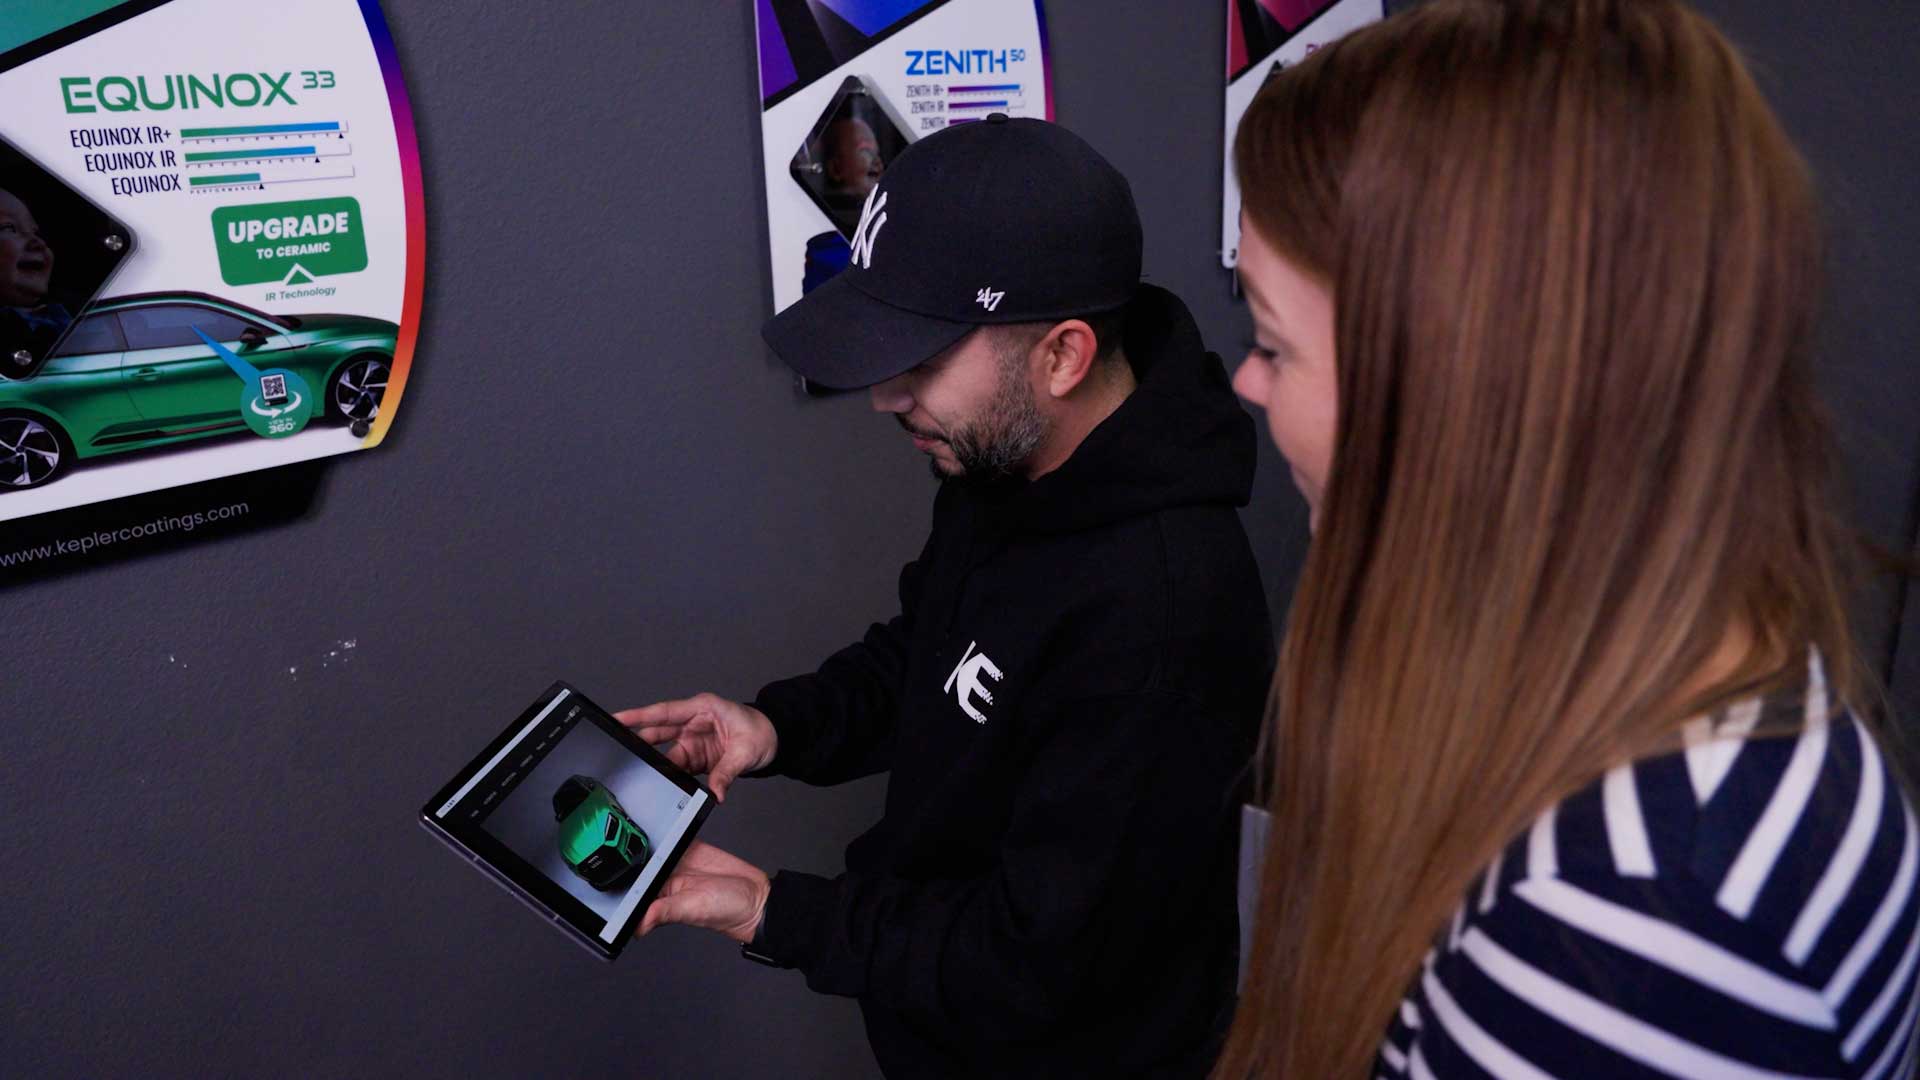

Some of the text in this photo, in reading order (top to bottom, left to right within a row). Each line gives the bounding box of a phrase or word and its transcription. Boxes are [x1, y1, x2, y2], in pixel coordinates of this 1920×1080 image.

[905, 49, 1026, 75] ZENITH 50
[59, 70, 336, 114] EQUINOX 33
[906, 84, 931, 98] ZENITH
[932, 83, 945, 96] IR+
[911, 101, 935, 114] ZENITH
[936, 100, 944, 112] IR
[921, 117, 945, 130] ZENITH
[70, 126, 172, 150] EQUINOX IR+
[84, 150, 177, 173] EQUINOX IR
[111, 174, 182, 196] EQUINOX
[228, 212, 349, 243] UPGRADE
[256, 242, 331, 259] TO CERAMIC
[266, 286, 337, 301] IR Technology
[0, 502, 250, 567] www.keplercoatings.com
